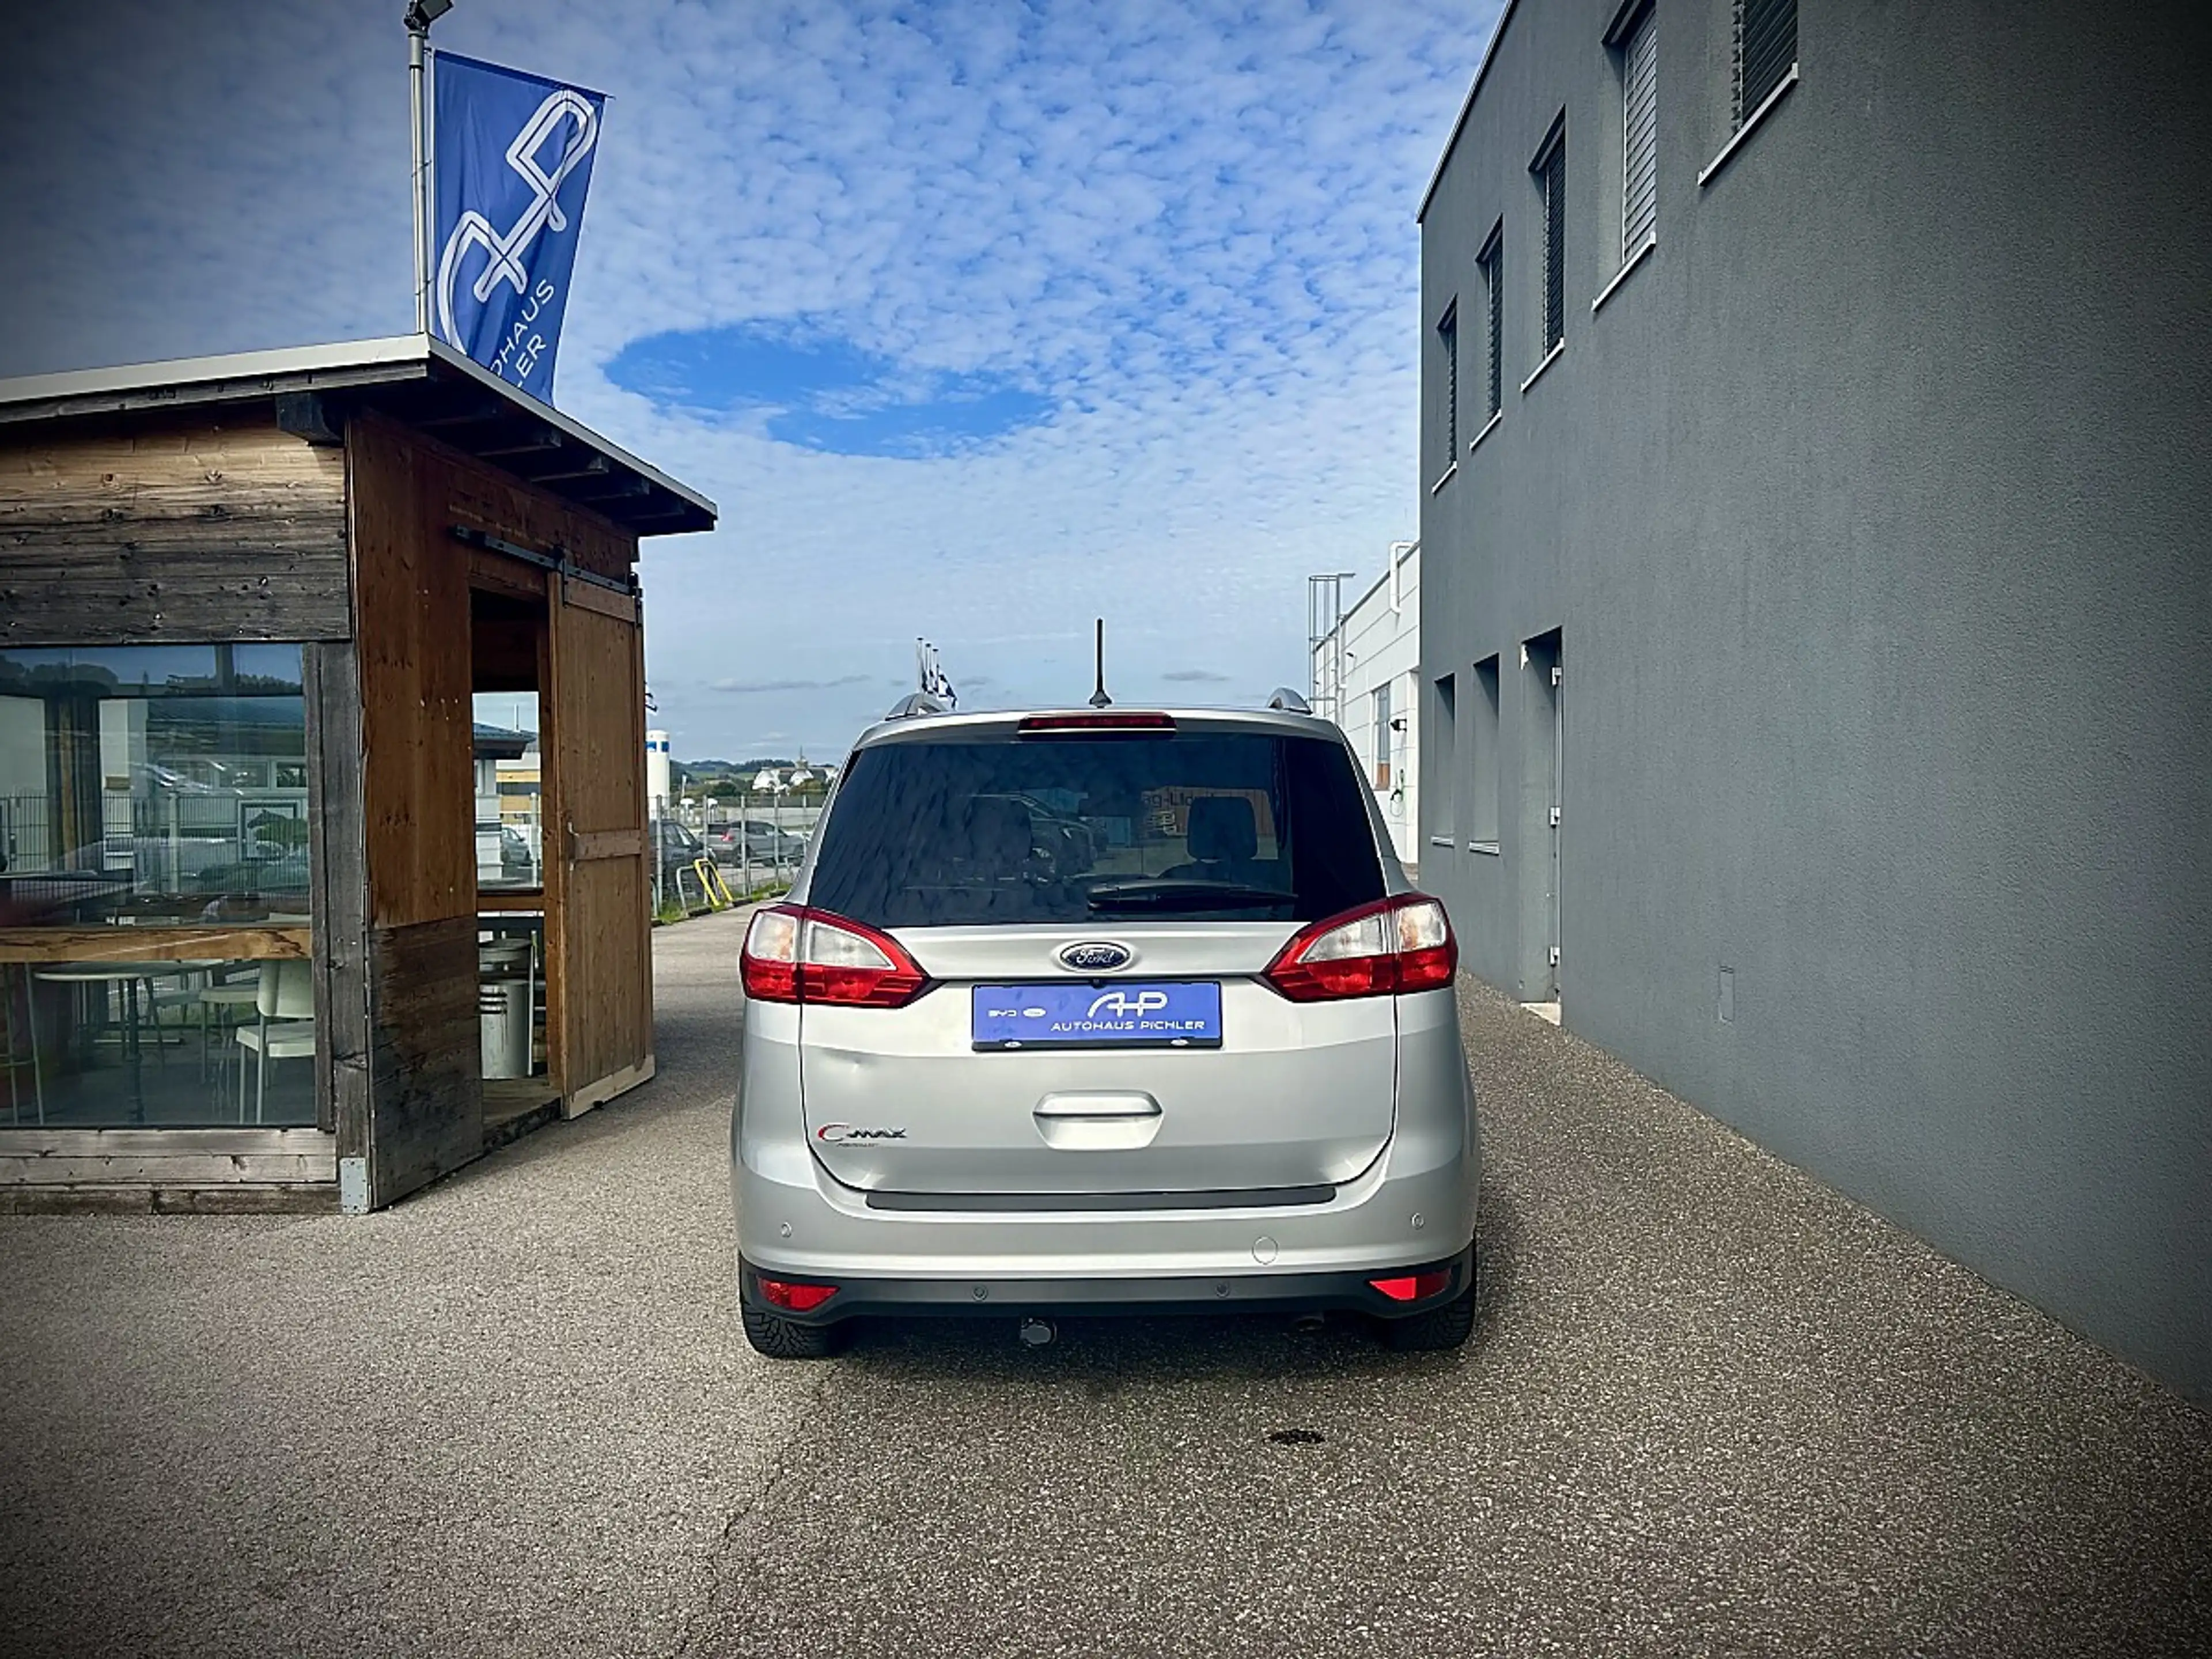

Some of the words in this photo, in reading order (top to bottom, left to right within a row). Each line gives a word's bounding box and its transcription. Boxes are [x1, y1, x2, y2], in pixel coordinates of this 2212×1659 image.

[1076, 948, 1115, 964] Ford
[1050, 1020, 1135, 1032] AUTOHAUS
[1139, 1020, 1206, 1031] PICHLER
